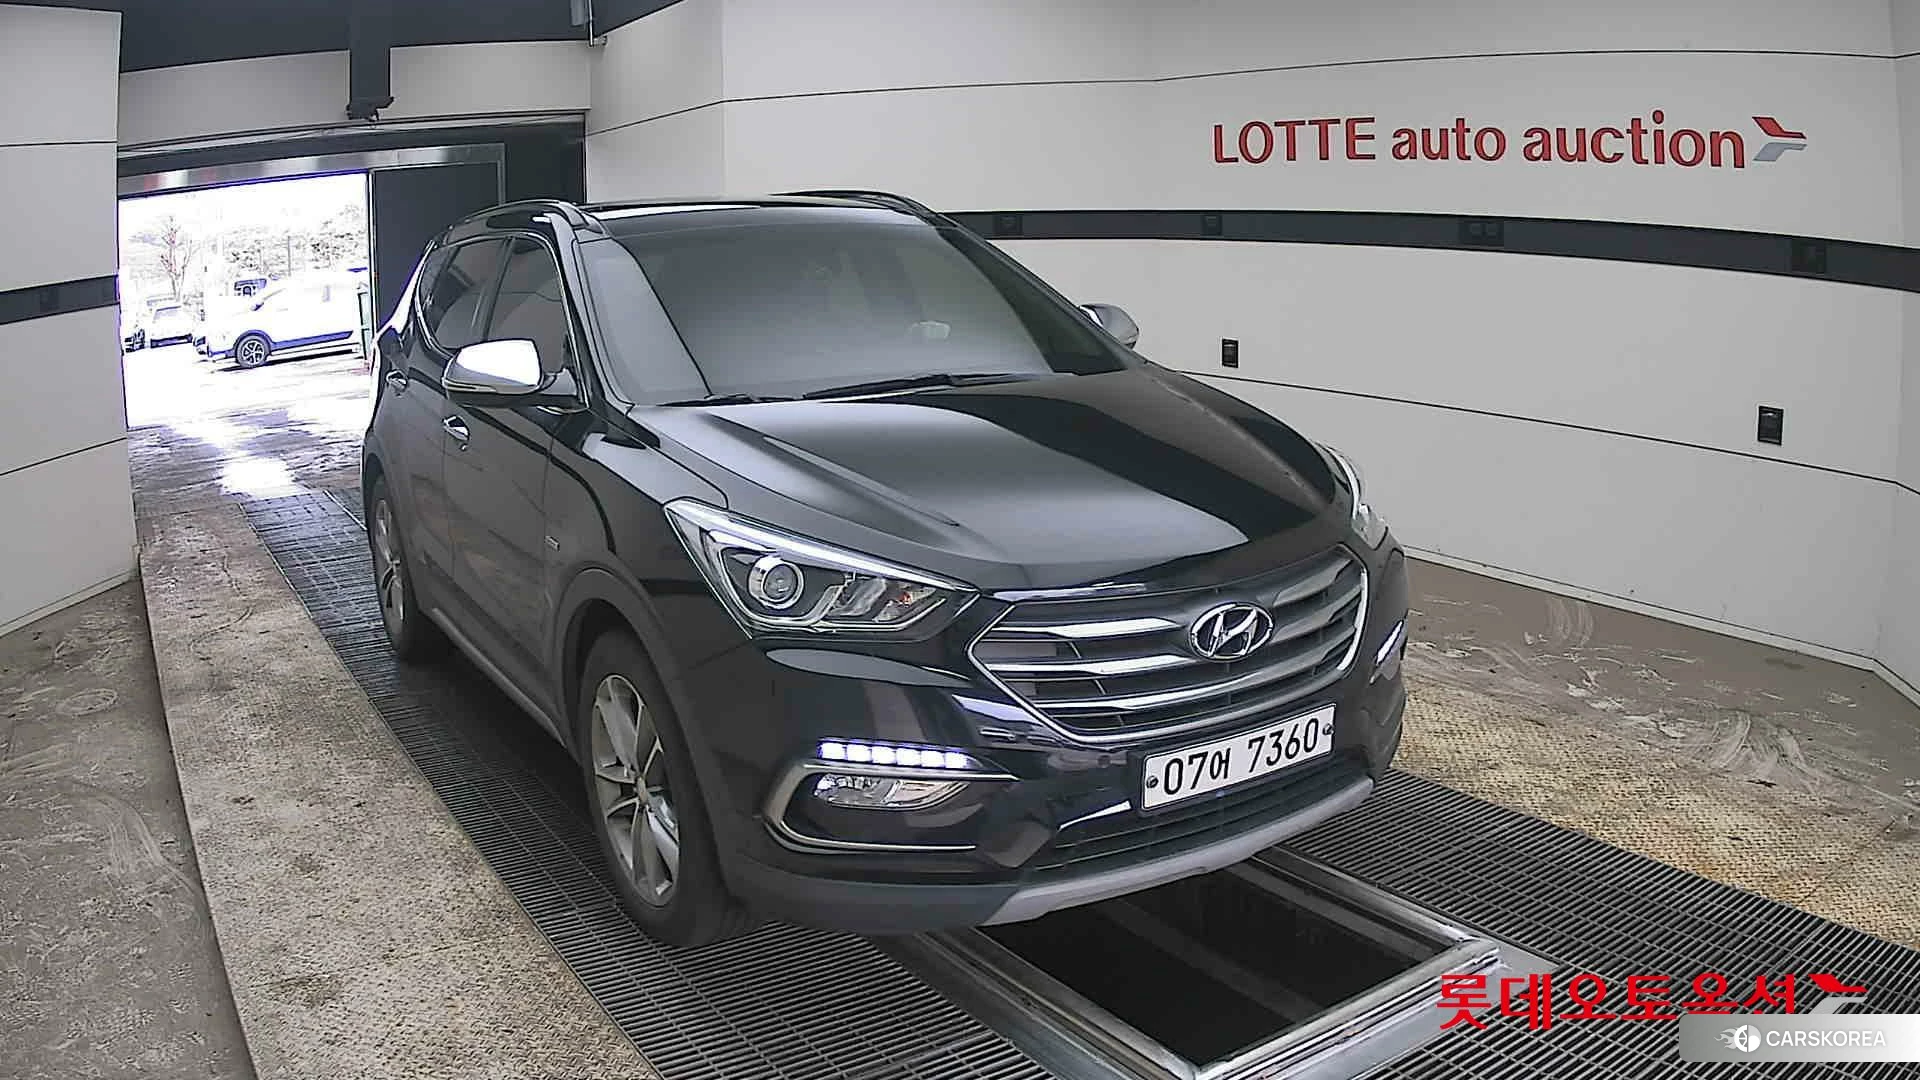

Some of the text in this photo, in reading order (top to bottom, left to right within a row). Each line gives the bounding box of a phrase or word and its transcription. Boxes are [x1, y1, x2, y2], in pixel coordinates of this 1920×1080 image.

[1212, 109, 1746, 168] LOTTE auto auction
[1163, 717, 1320, 796] 07어 7360
